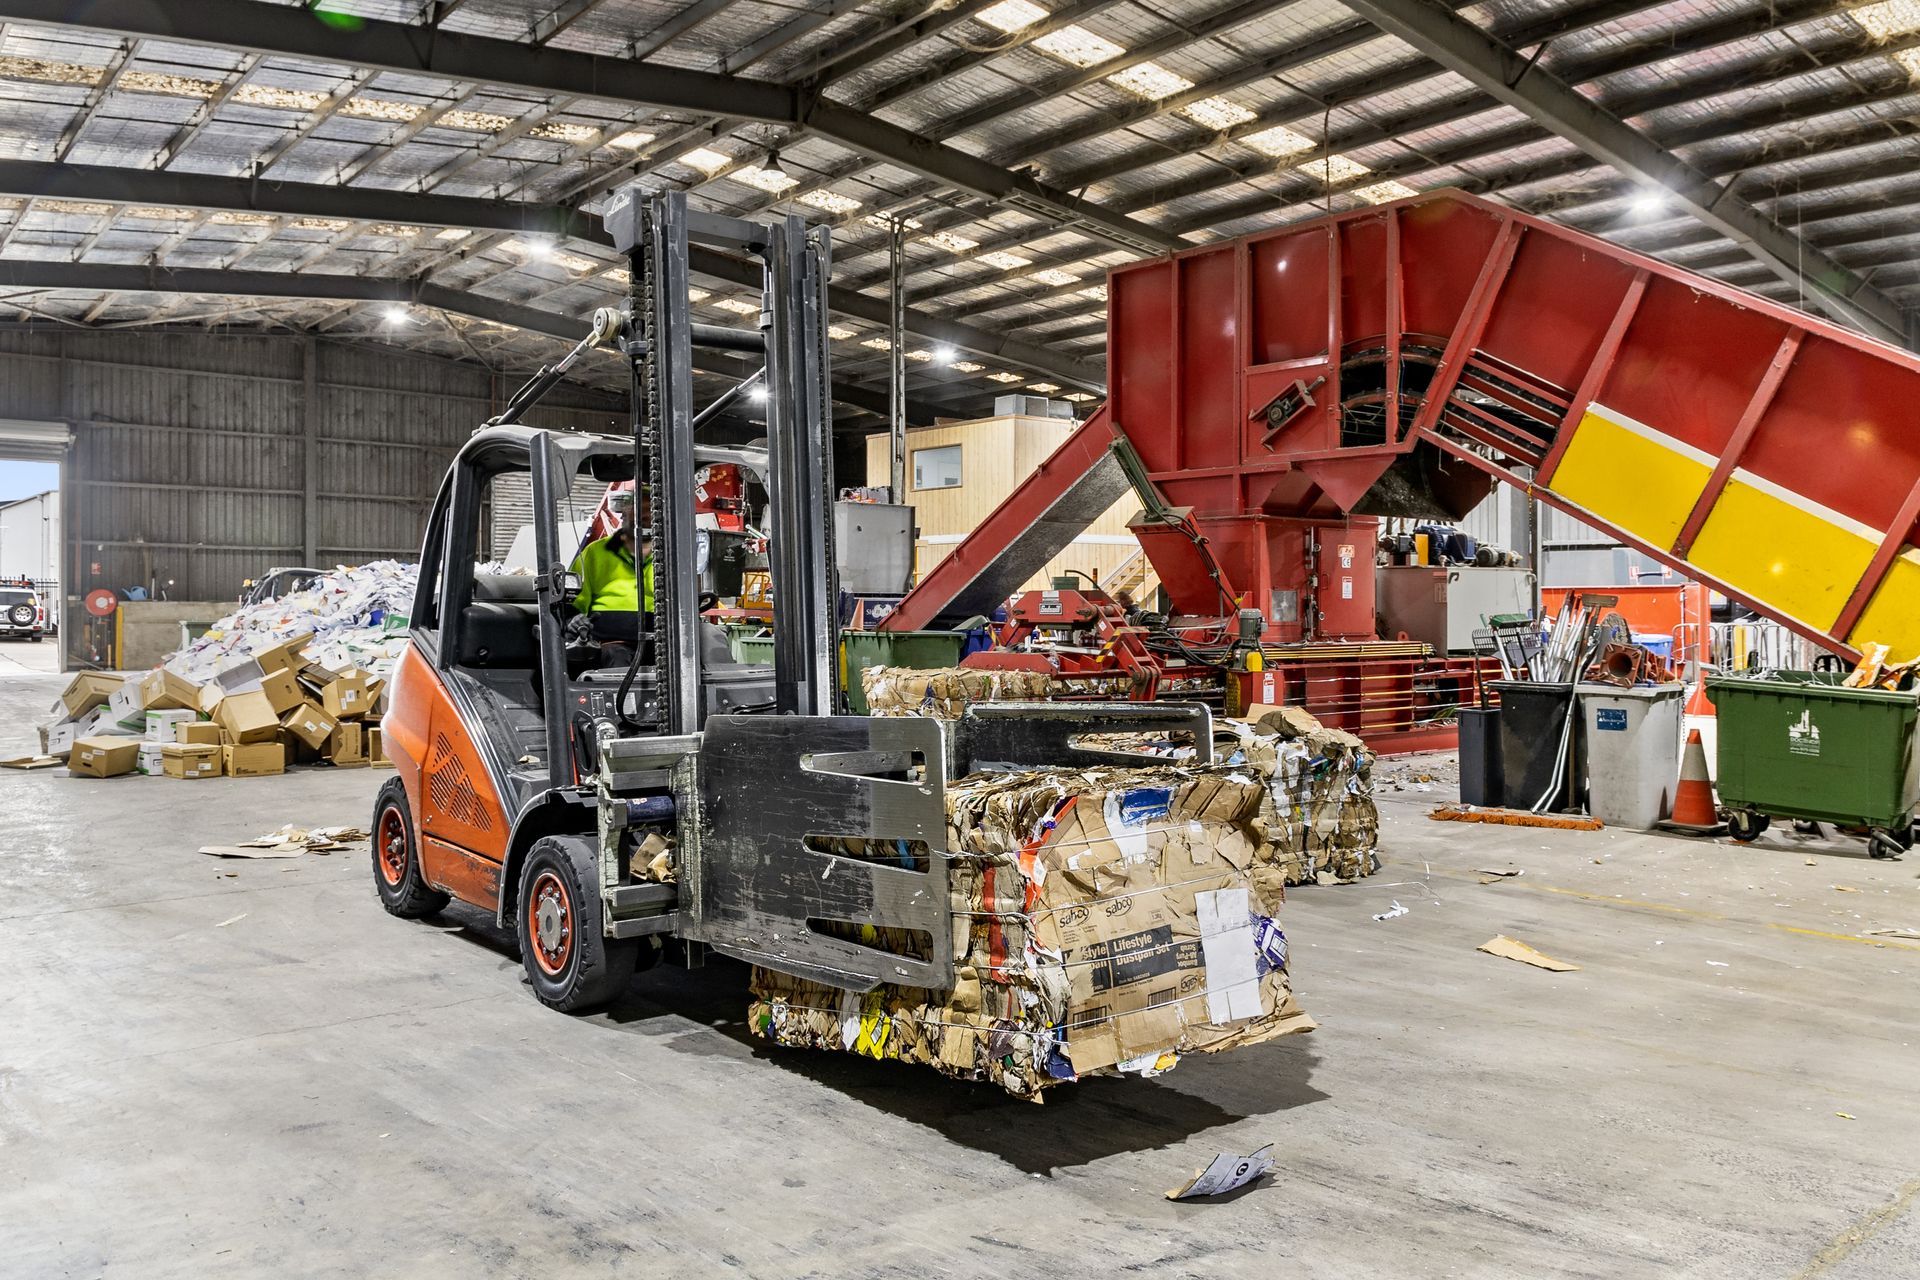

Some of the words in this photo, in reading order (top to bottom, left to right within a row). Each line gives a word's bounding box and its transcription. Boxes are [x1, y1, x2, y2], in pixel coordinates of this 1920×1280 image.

[1105, 897, 1133, 917] sabco
[1078, 945, 1106, 959] style
[1113, 933, 1152, 952] Lifestyle
